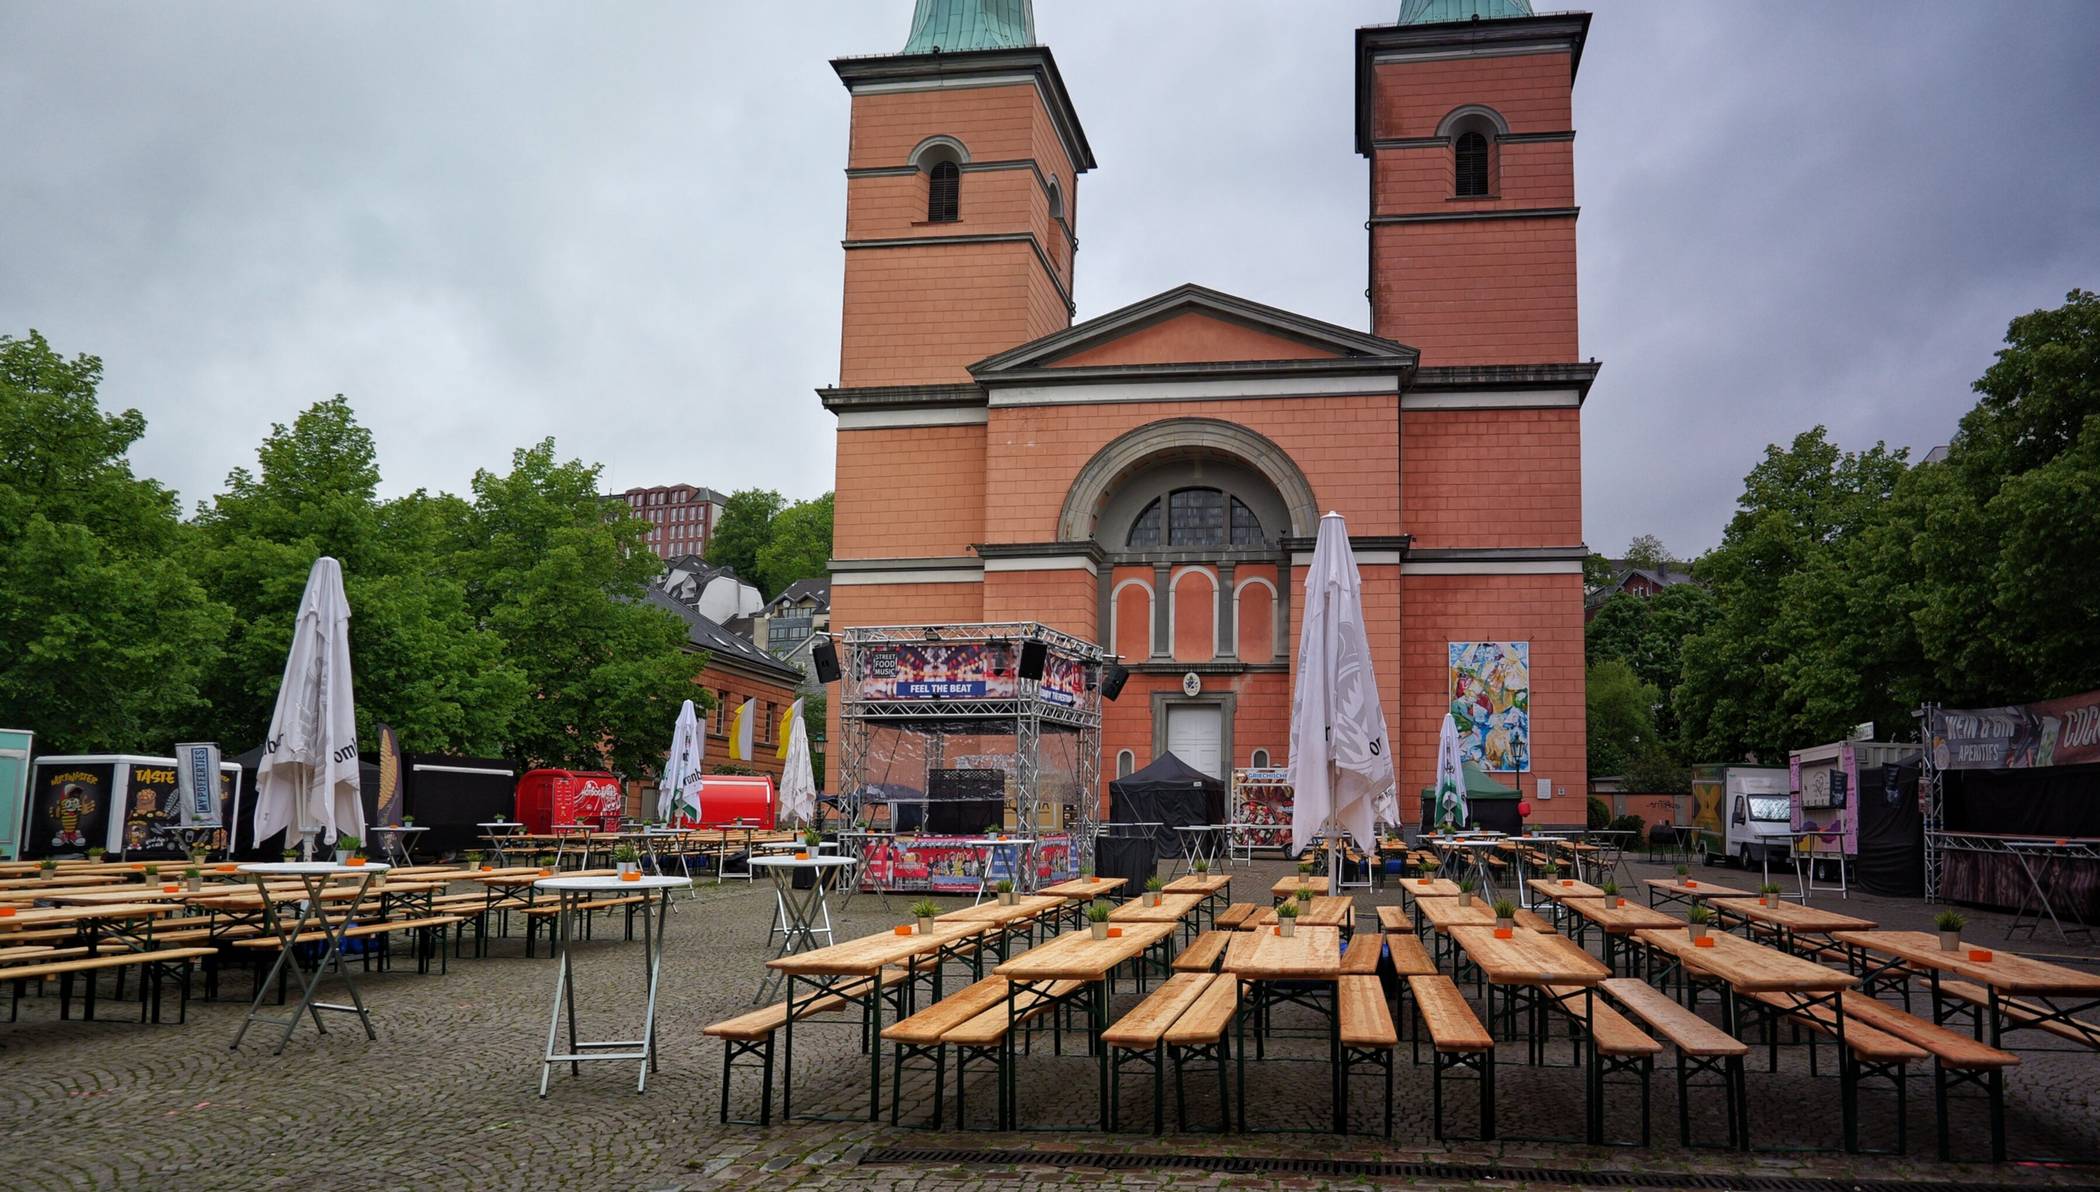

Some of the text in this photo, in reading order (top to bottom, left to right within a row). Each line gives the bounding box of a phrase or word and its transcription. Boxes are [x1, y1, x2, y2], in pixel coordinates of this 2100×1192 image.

[875, 660, 896, 668] FOOD
[910, 684, 972, 693] FEEL THE BEAT
[1945, 715, 1979, 740] WEIN
[1958, 743, 1999, 762] APERITIFS
[136, 768, 177, 785] TASTE
[197, 799, 209, 811] MY
